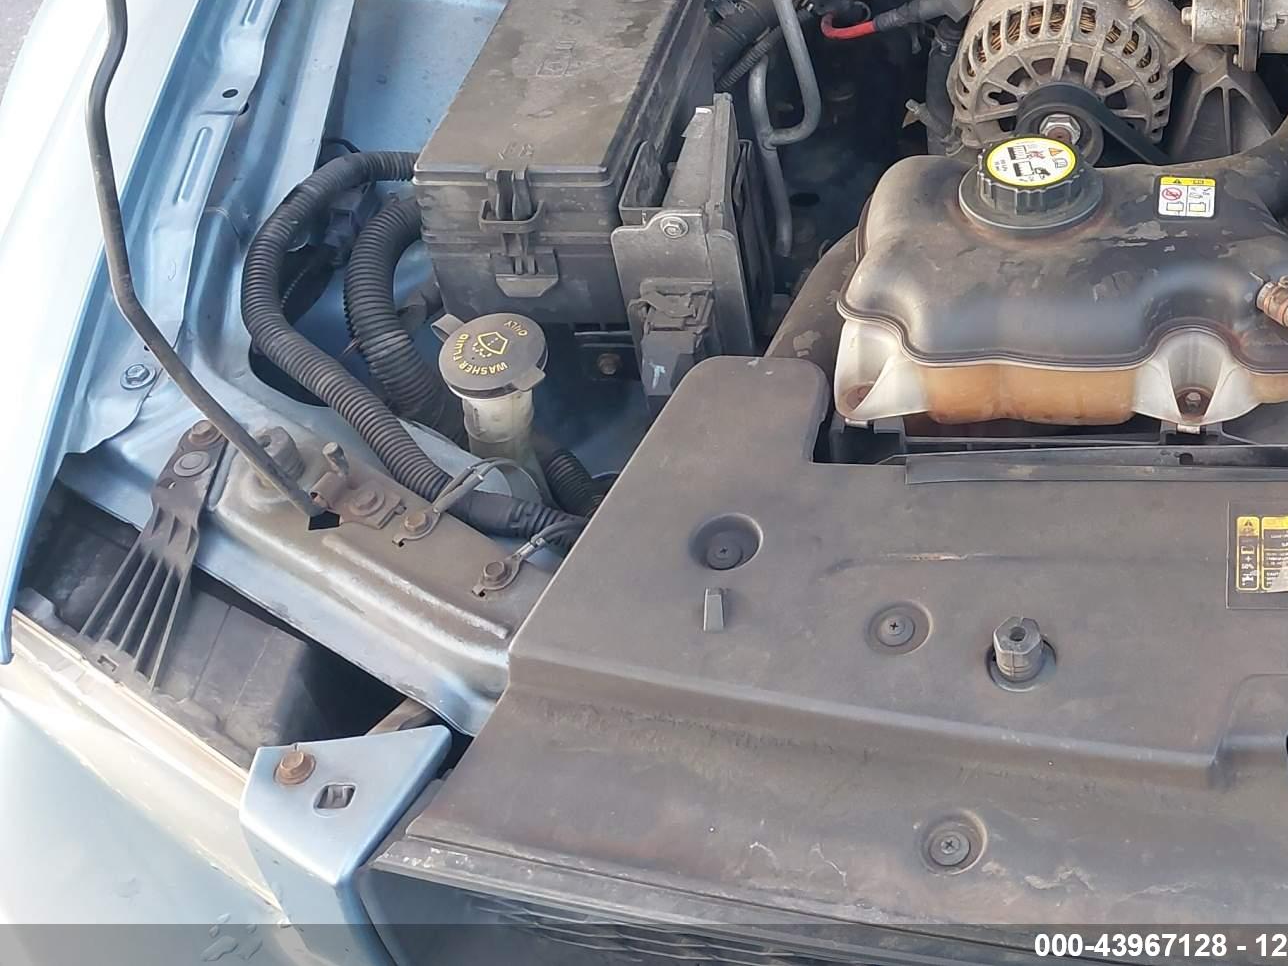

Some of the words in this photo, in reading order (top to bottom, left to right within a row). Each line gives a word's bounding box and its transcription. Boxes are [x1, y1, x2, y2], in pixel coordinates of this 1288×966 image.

[503, 320, 528, 337] ONLY
[452, 333, 470, 361] FLUID
[459, 360, 509, 376] WASHER
